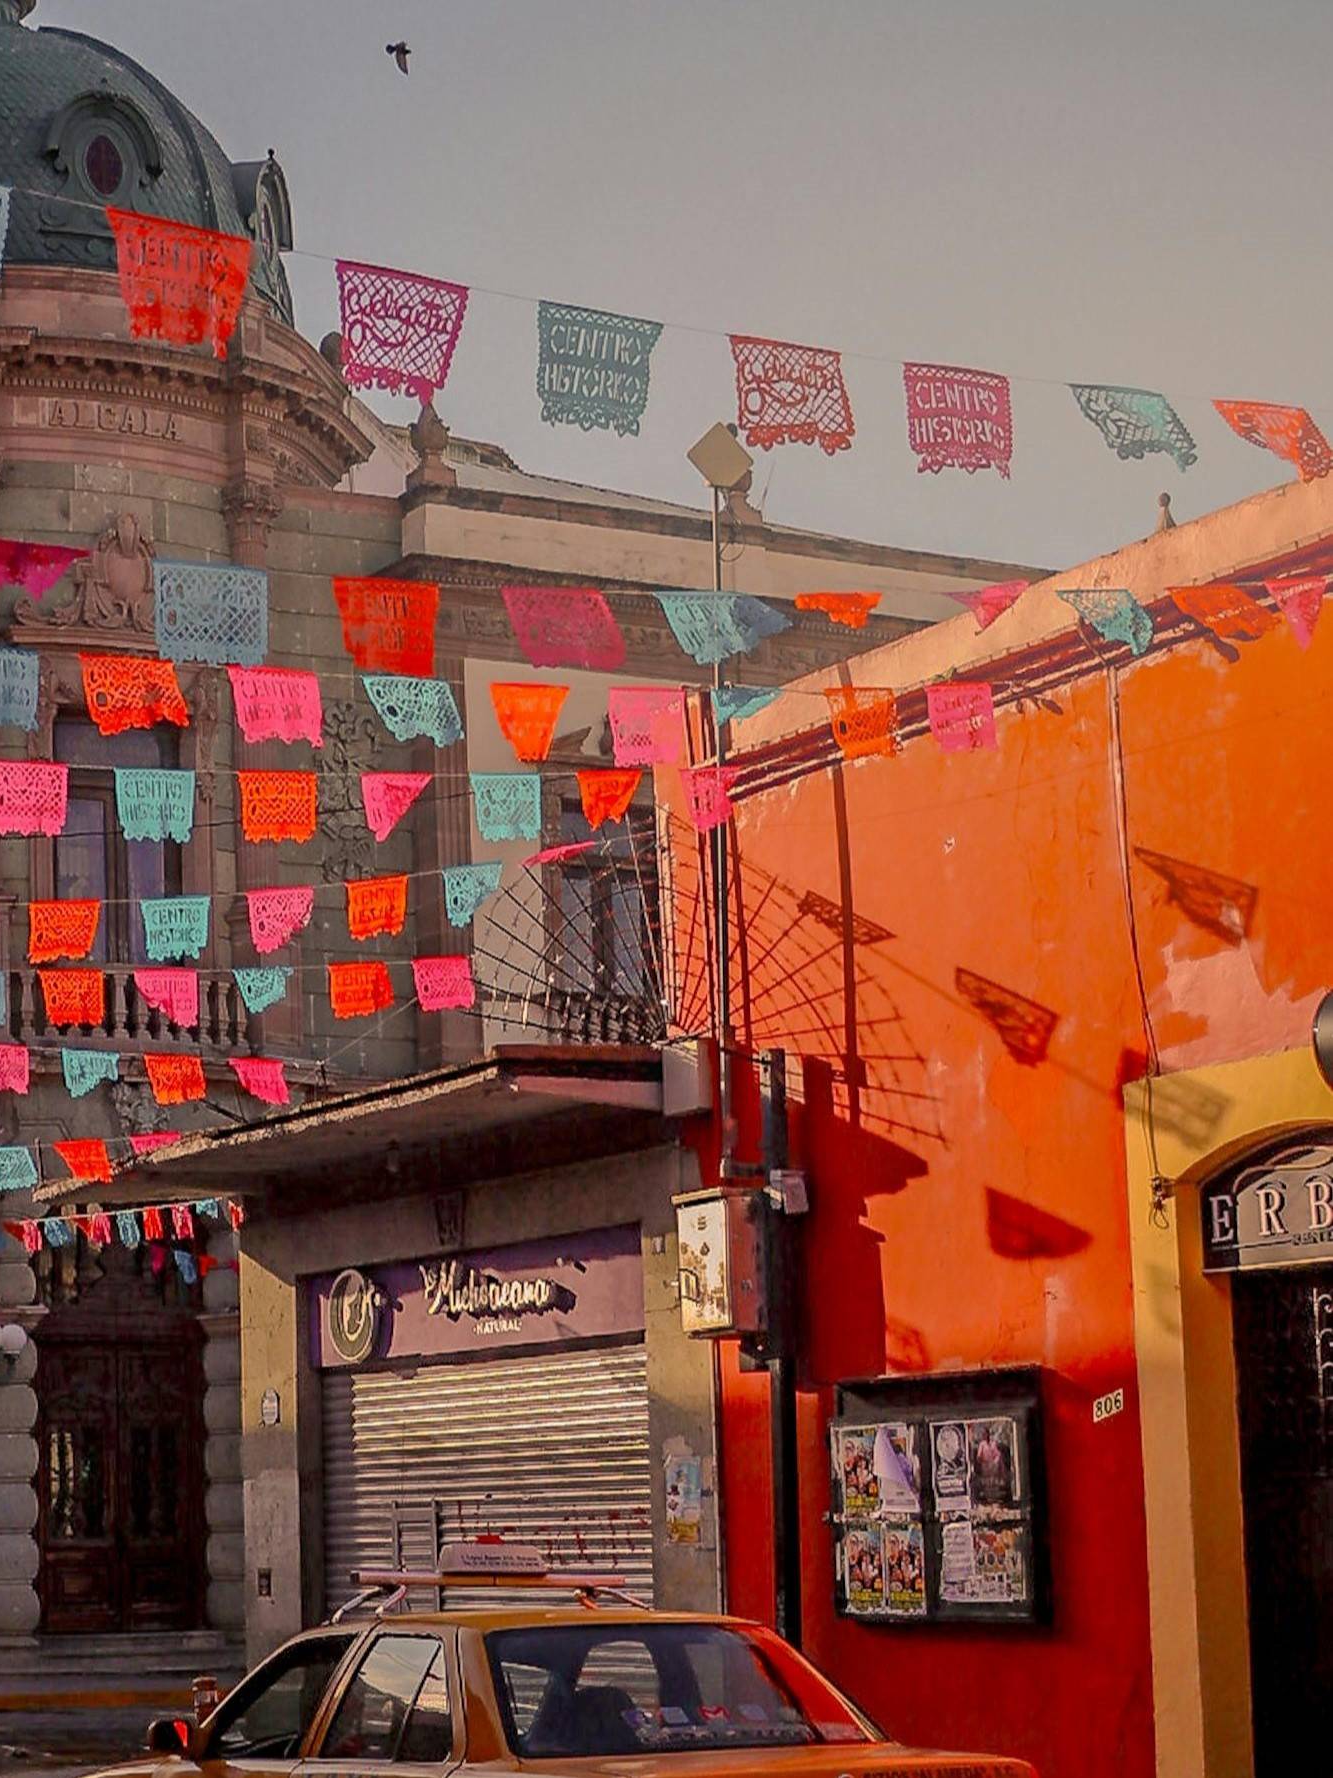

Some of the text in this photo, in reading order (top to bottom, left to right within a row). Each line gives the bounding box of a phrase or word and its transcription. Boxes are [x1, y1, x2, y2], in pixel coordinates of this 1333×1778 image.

[550, 325, 642, 367] CENTRO
[543, 357, 640, 404] HISTÓRICO
[915, 381, 999, 416] CENTRO
[429, 1260, 550, 1315] Michoacana
[1096, 1392, 1122, 1418] 806
